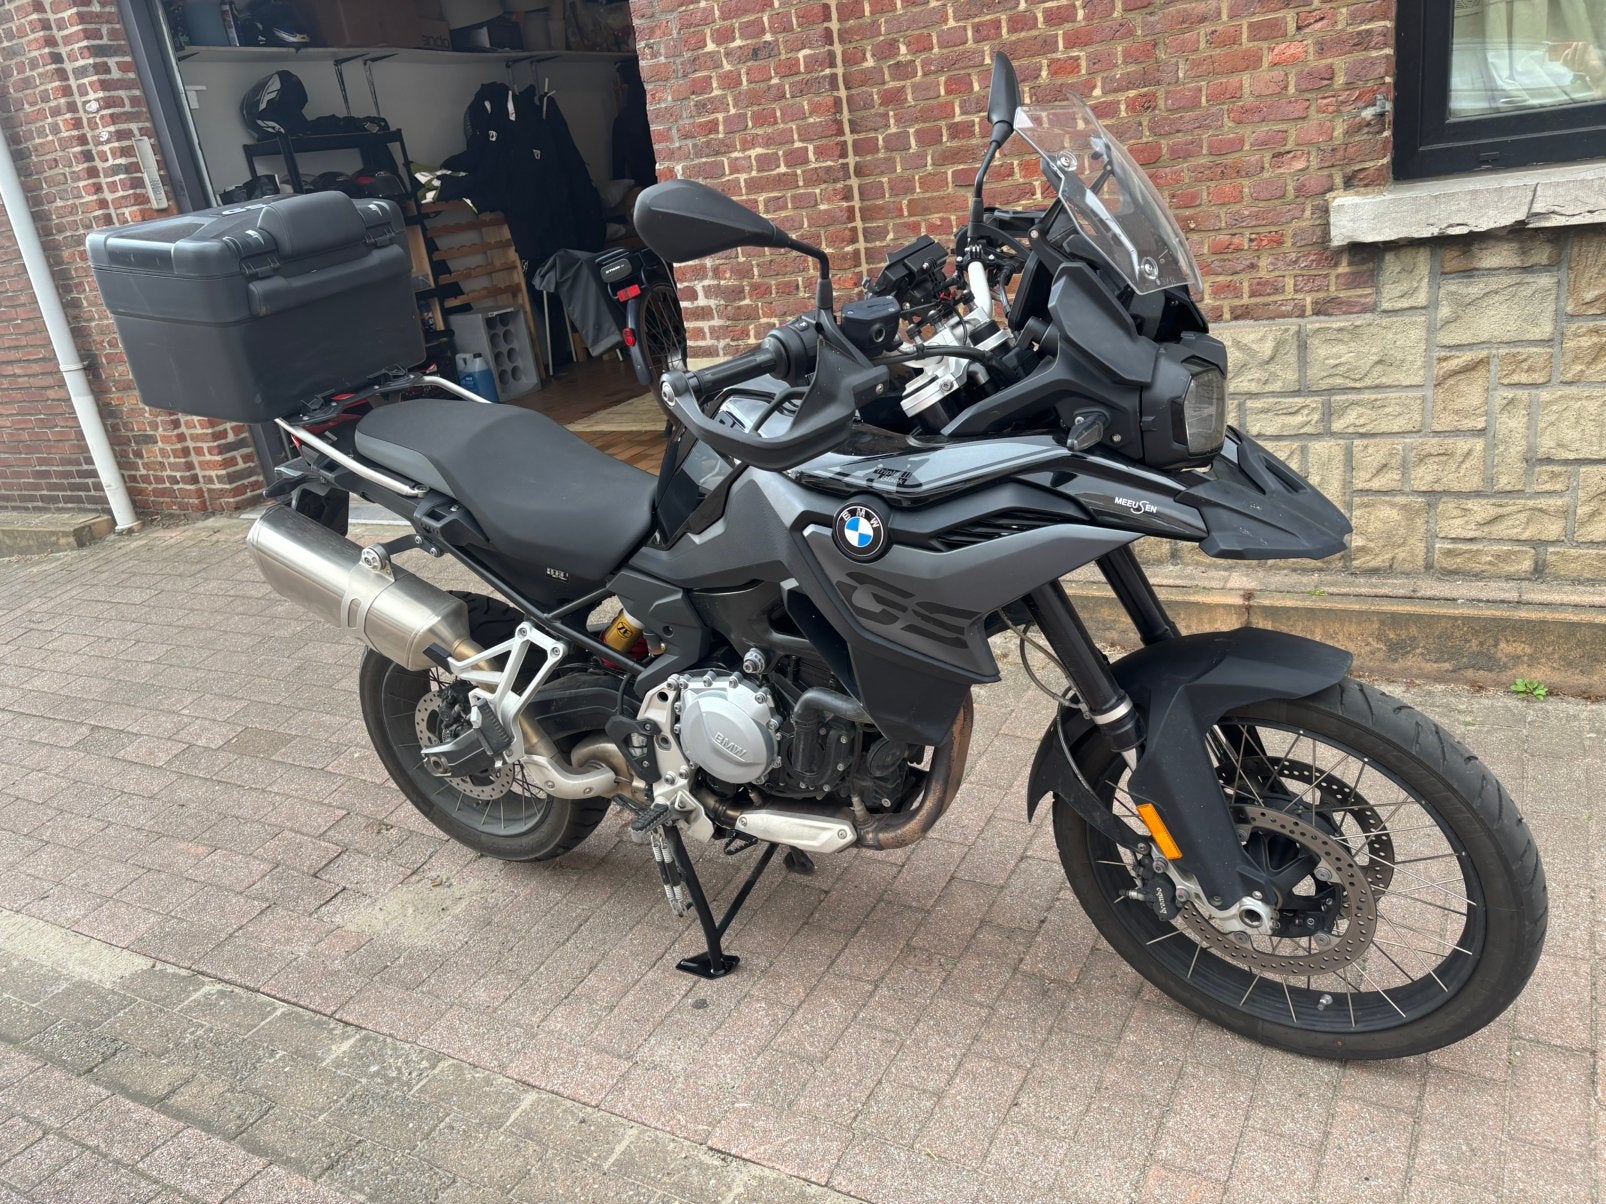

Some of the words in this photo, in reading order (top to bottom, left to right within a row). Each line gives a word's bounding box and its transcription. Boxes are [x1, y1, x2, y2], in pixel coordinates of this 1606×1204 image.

[841, 507, 880, 528] BMW
[835, 571, 983, 649] GS
[713, 731, 747, 758] BMW
[1156, 887, 1168, 914] brembo
